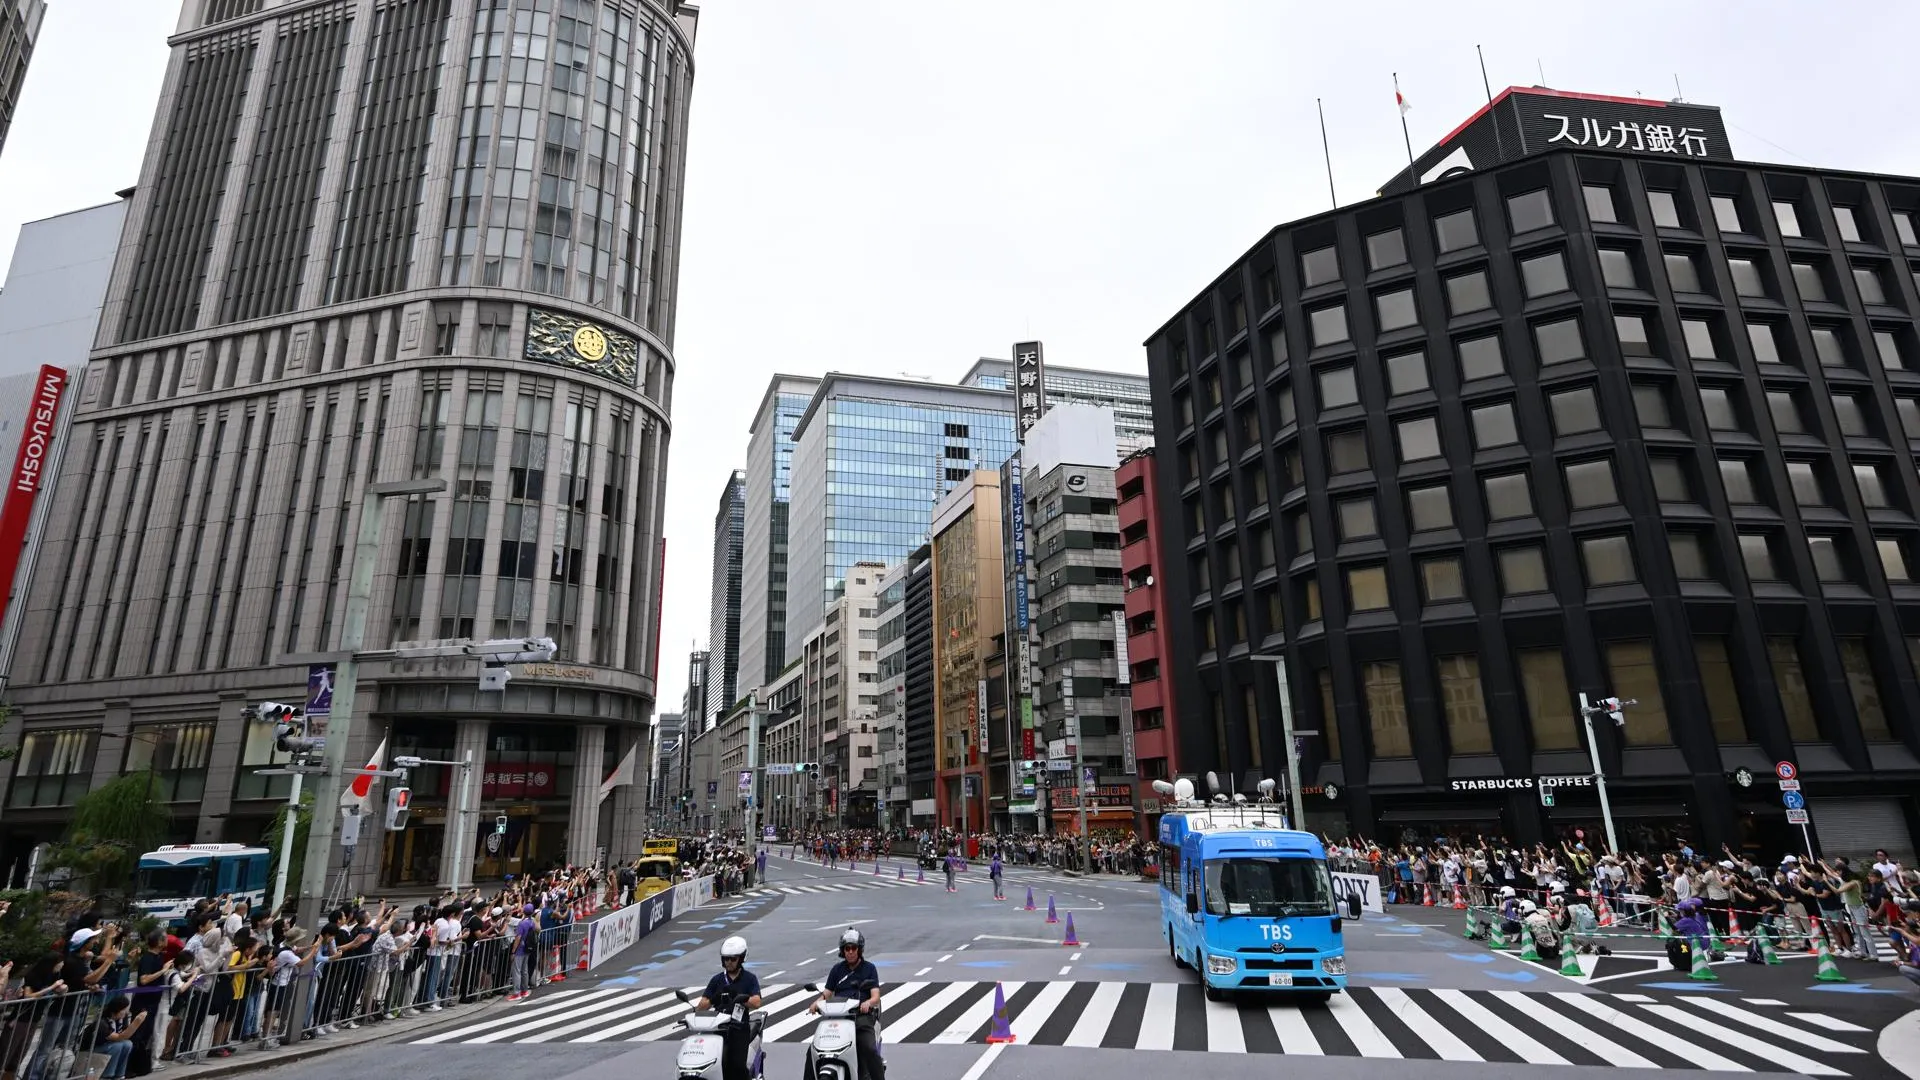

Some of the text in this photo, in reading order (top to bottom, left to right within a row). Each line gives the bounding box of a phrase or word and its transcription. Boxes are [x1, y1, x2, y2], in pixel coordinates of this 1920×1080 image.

[1543, 113, 1708, 157] スルガ銀行
[1019, 350, 1038, 429] 天野歯科
[17, 374, 62, 492] MITSUKOSHI
[523, 662, 594, 681] MITSUKOSHI
[896, 699, 905, 767] 山本海苔店
[1451, 778, 1533, 790] STARBUCKS
[766, 826, 775, 834] 15
[1255, 839, 1273, 847] TBS
[1332, 875, 1370, 906] ONY
[1260, 924, 1293, 941] TBS
